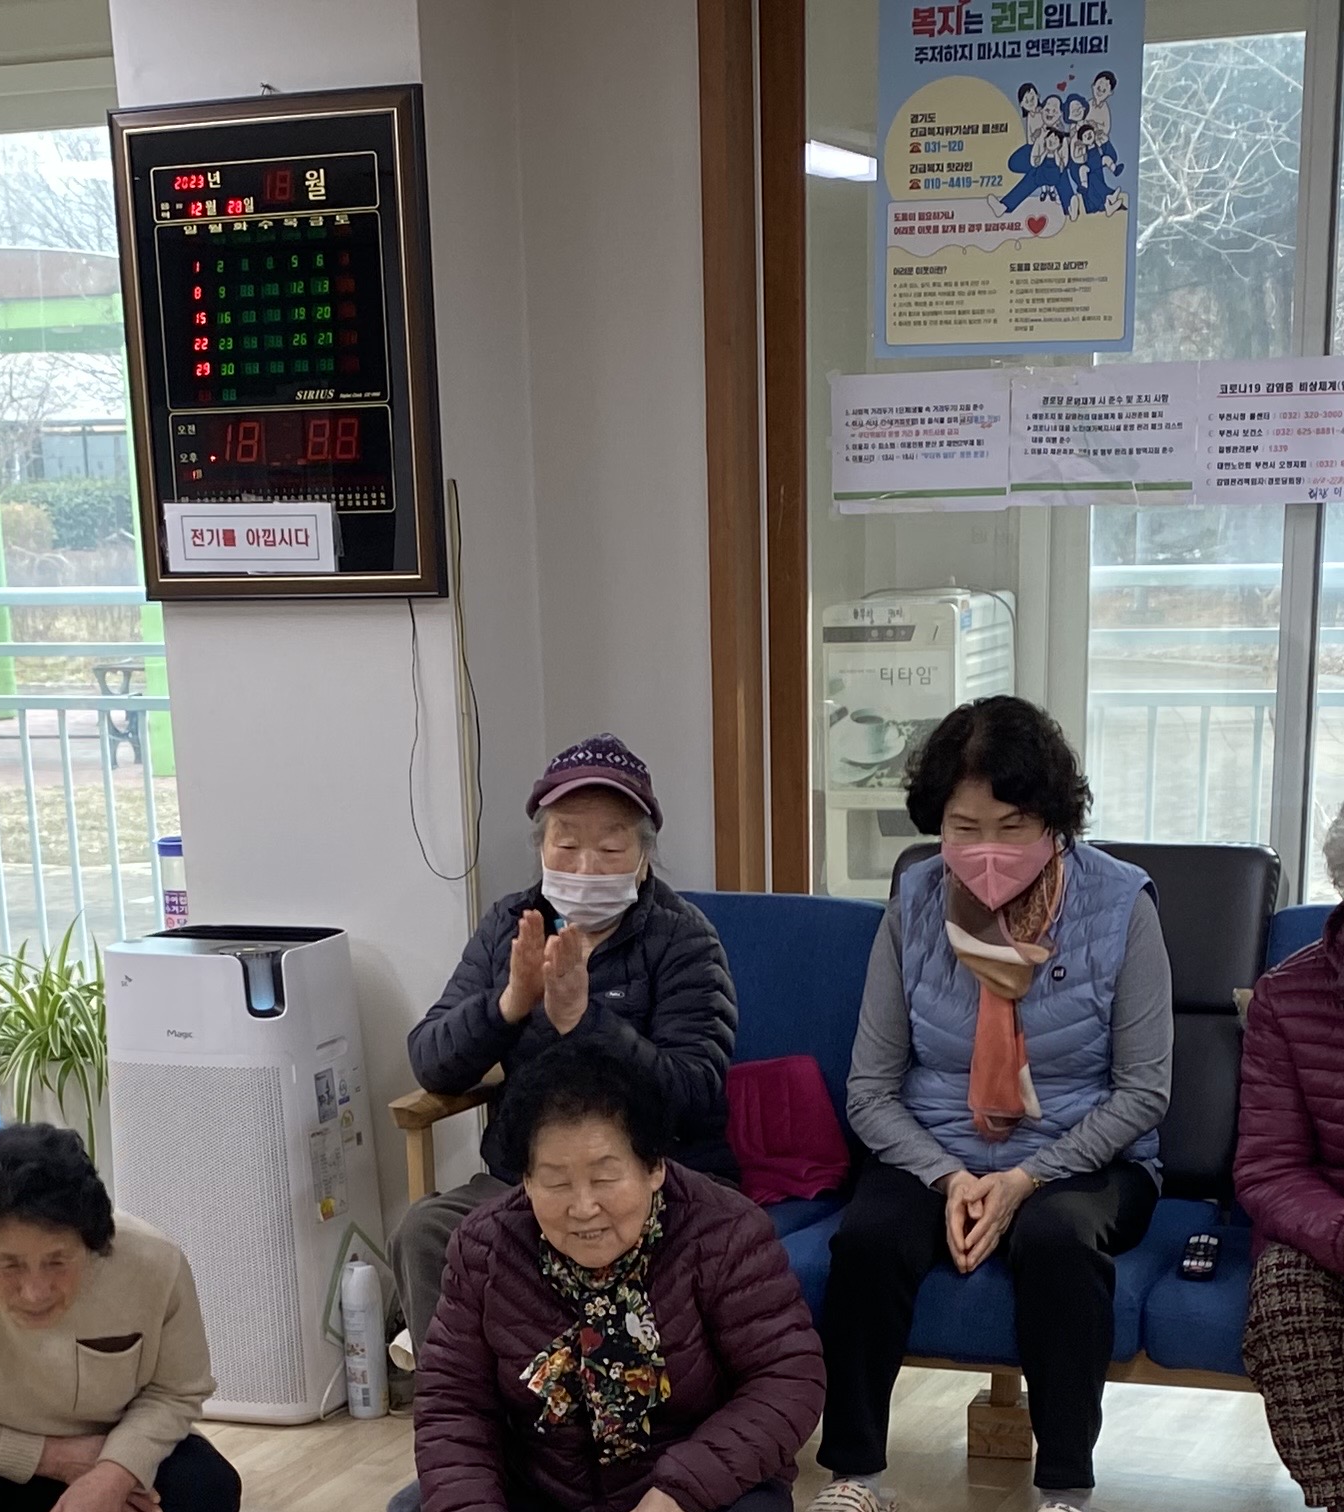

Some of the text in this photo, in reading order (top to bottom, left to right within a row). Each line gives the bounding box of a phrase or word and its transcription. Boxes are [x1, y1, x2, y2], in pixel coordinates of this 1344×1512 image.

[912, 0, 1113, 38] 복지는 권리입니다.
[914, 35, 1109, 65] 주저하지 마시고 연락주세요!
[910, 113, 936, 124] 경기도
[924, 140, 964, 153] 031-120
[946, 161, 973, 172] 핫라인
[304, 168, 327, 200] 월
[924, 175, 1003, 189] 010-4419-7722
[183, 214, 350, 235] 일 월 화 수 목 금 토
[195, 312, 207, 325] 15
[219, 311, 232, 324] 16
[316, 306, 331, 319] 20
[194, 332, 333, 350] 22 23 26 27
[196, 362, 235, 376] 29 30
[295, 388, 335, 400] SIRIUS
[1219, 383, 1261, 394] 코로나19
[1266, 382, 1294, 393] 감염증
[177, 423, 197, 435] 오전
[179, 452, 199, 464] 오후
[190, 527, 310, 548] 전기를 아낍시다
[880, 666, 932, 686] 티타임
[166, 1029, 193, 1039] Magic
